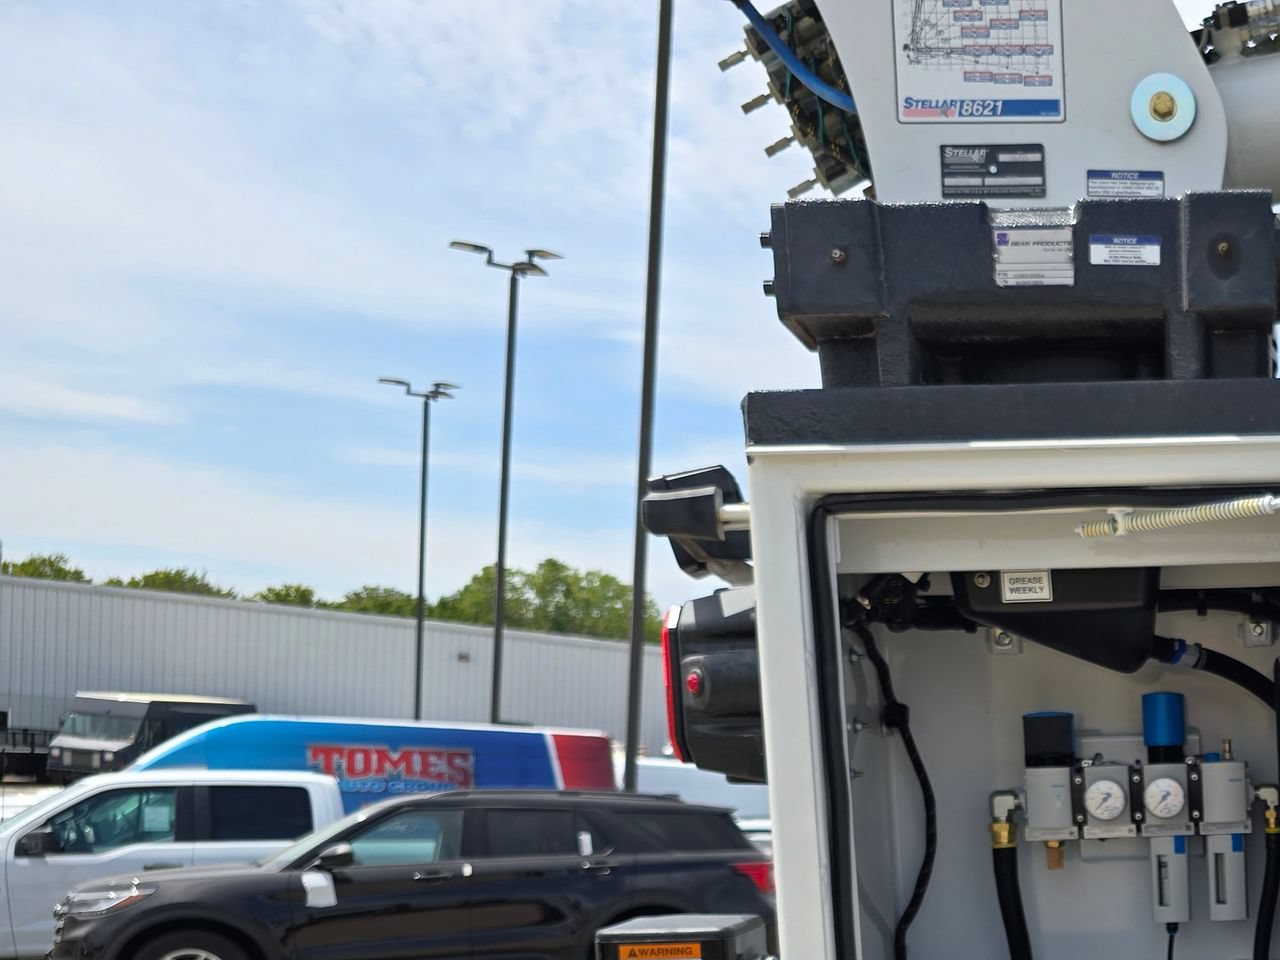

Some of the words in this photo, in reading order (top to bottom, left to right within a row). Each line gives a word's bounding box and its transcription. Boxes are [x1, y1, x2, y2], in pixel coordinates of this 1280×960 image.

[903, 97, 958, 110] STELLAR
[961, 101, 1003, 117] 8621
[944, 147, 987, 158] STELLAR
[1111, 172, 1140, 180] NOTICE
[1009, 576, 1044, 585] GREASE
[1009, 586, 1045, 595] WEEKLY
[308, 744, 475, 790] TOMES
[639, 946, 693, 957] WARNING
